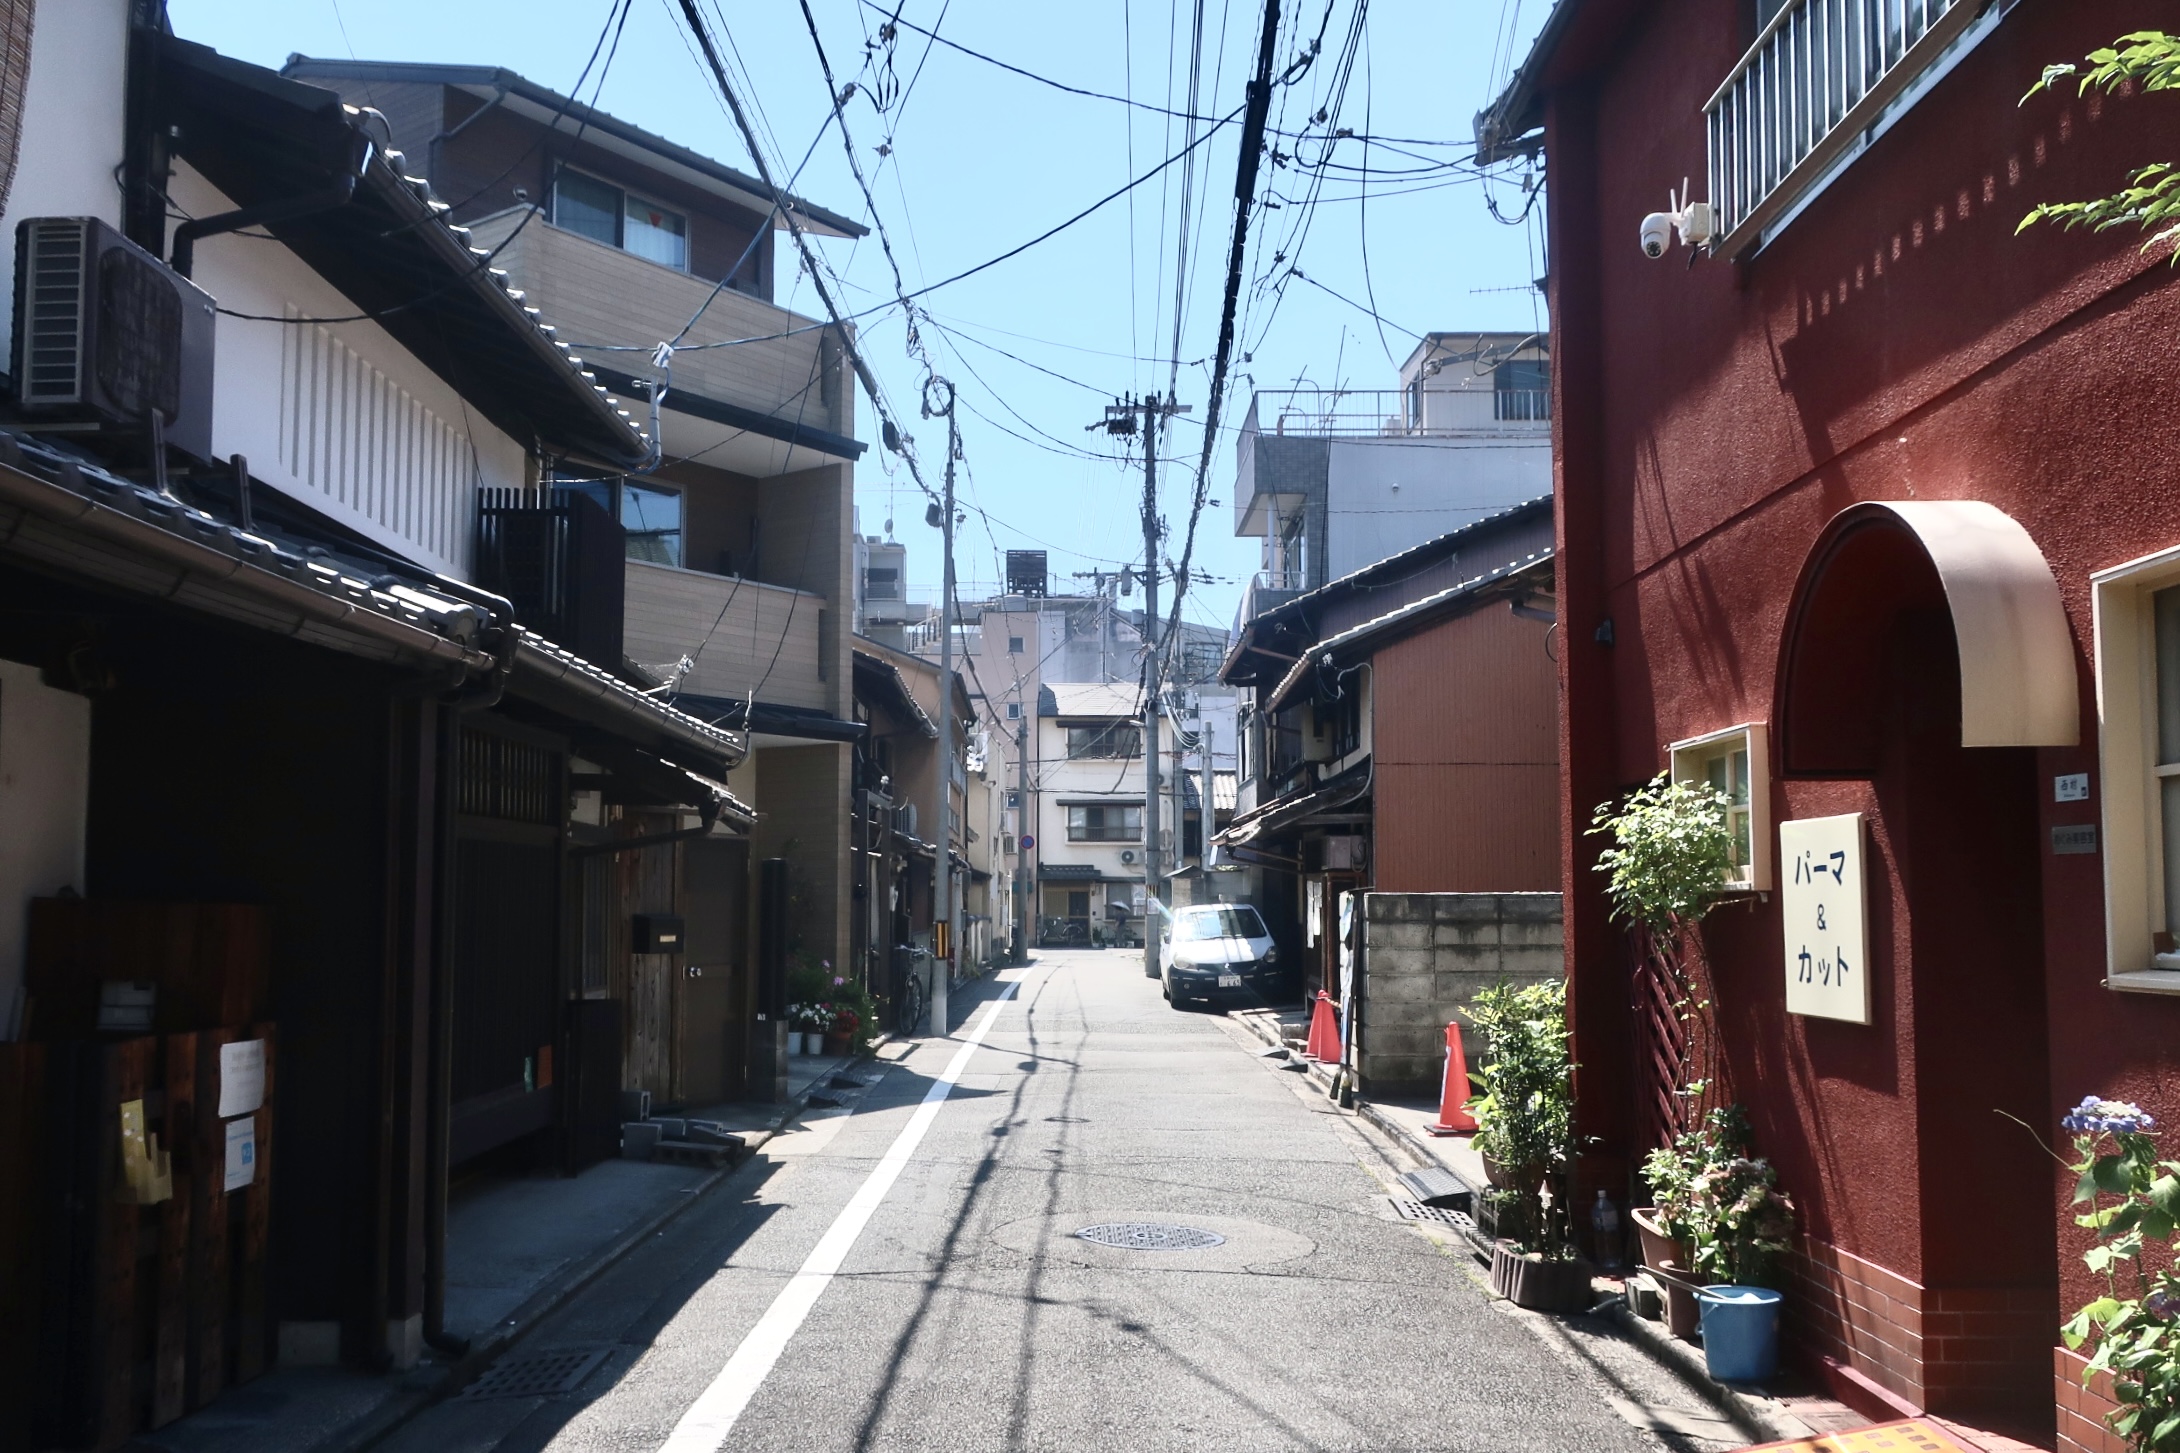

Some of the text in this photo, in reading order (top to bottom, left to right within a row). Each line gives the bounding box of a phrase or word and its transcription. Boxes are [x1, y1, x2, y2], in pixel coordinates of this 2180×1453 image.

[1795, 850, 1845, 886] パーマ
[1816, 904, 1827, 931] &
[1798, 944, 1849, 987] カット
